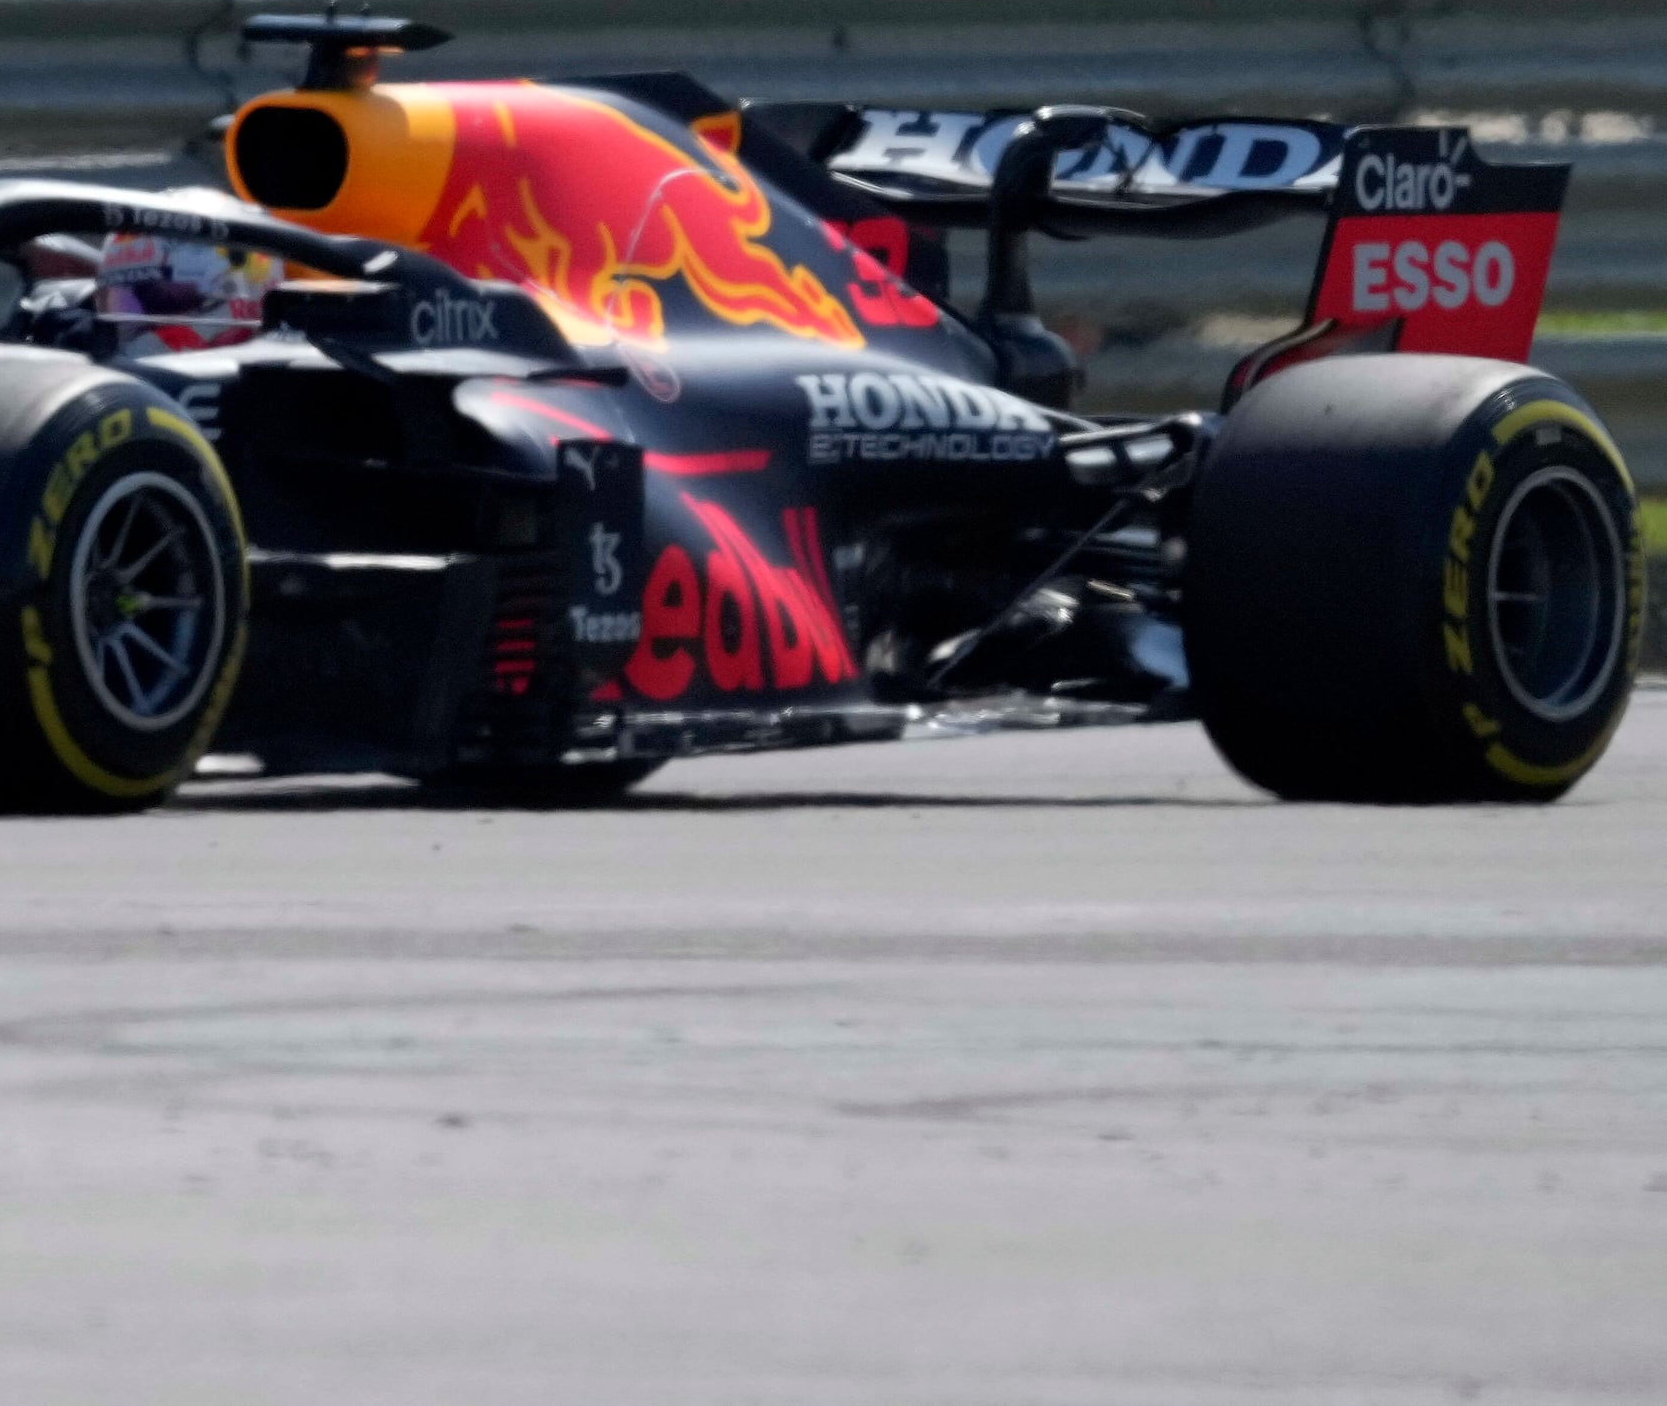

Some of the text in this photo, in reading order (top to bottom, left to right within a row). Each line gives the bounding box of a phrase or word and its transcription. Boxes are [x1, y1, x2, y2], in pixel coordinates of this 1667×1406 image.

[1355, 154, 1455, 211] Claro
[1352, 241, 1515, 311] ESSO
[410, 289, 500, 344] citrix
[796, 372, 1052, 431] HONDA
[27, 397, 132, 580] ZERO
